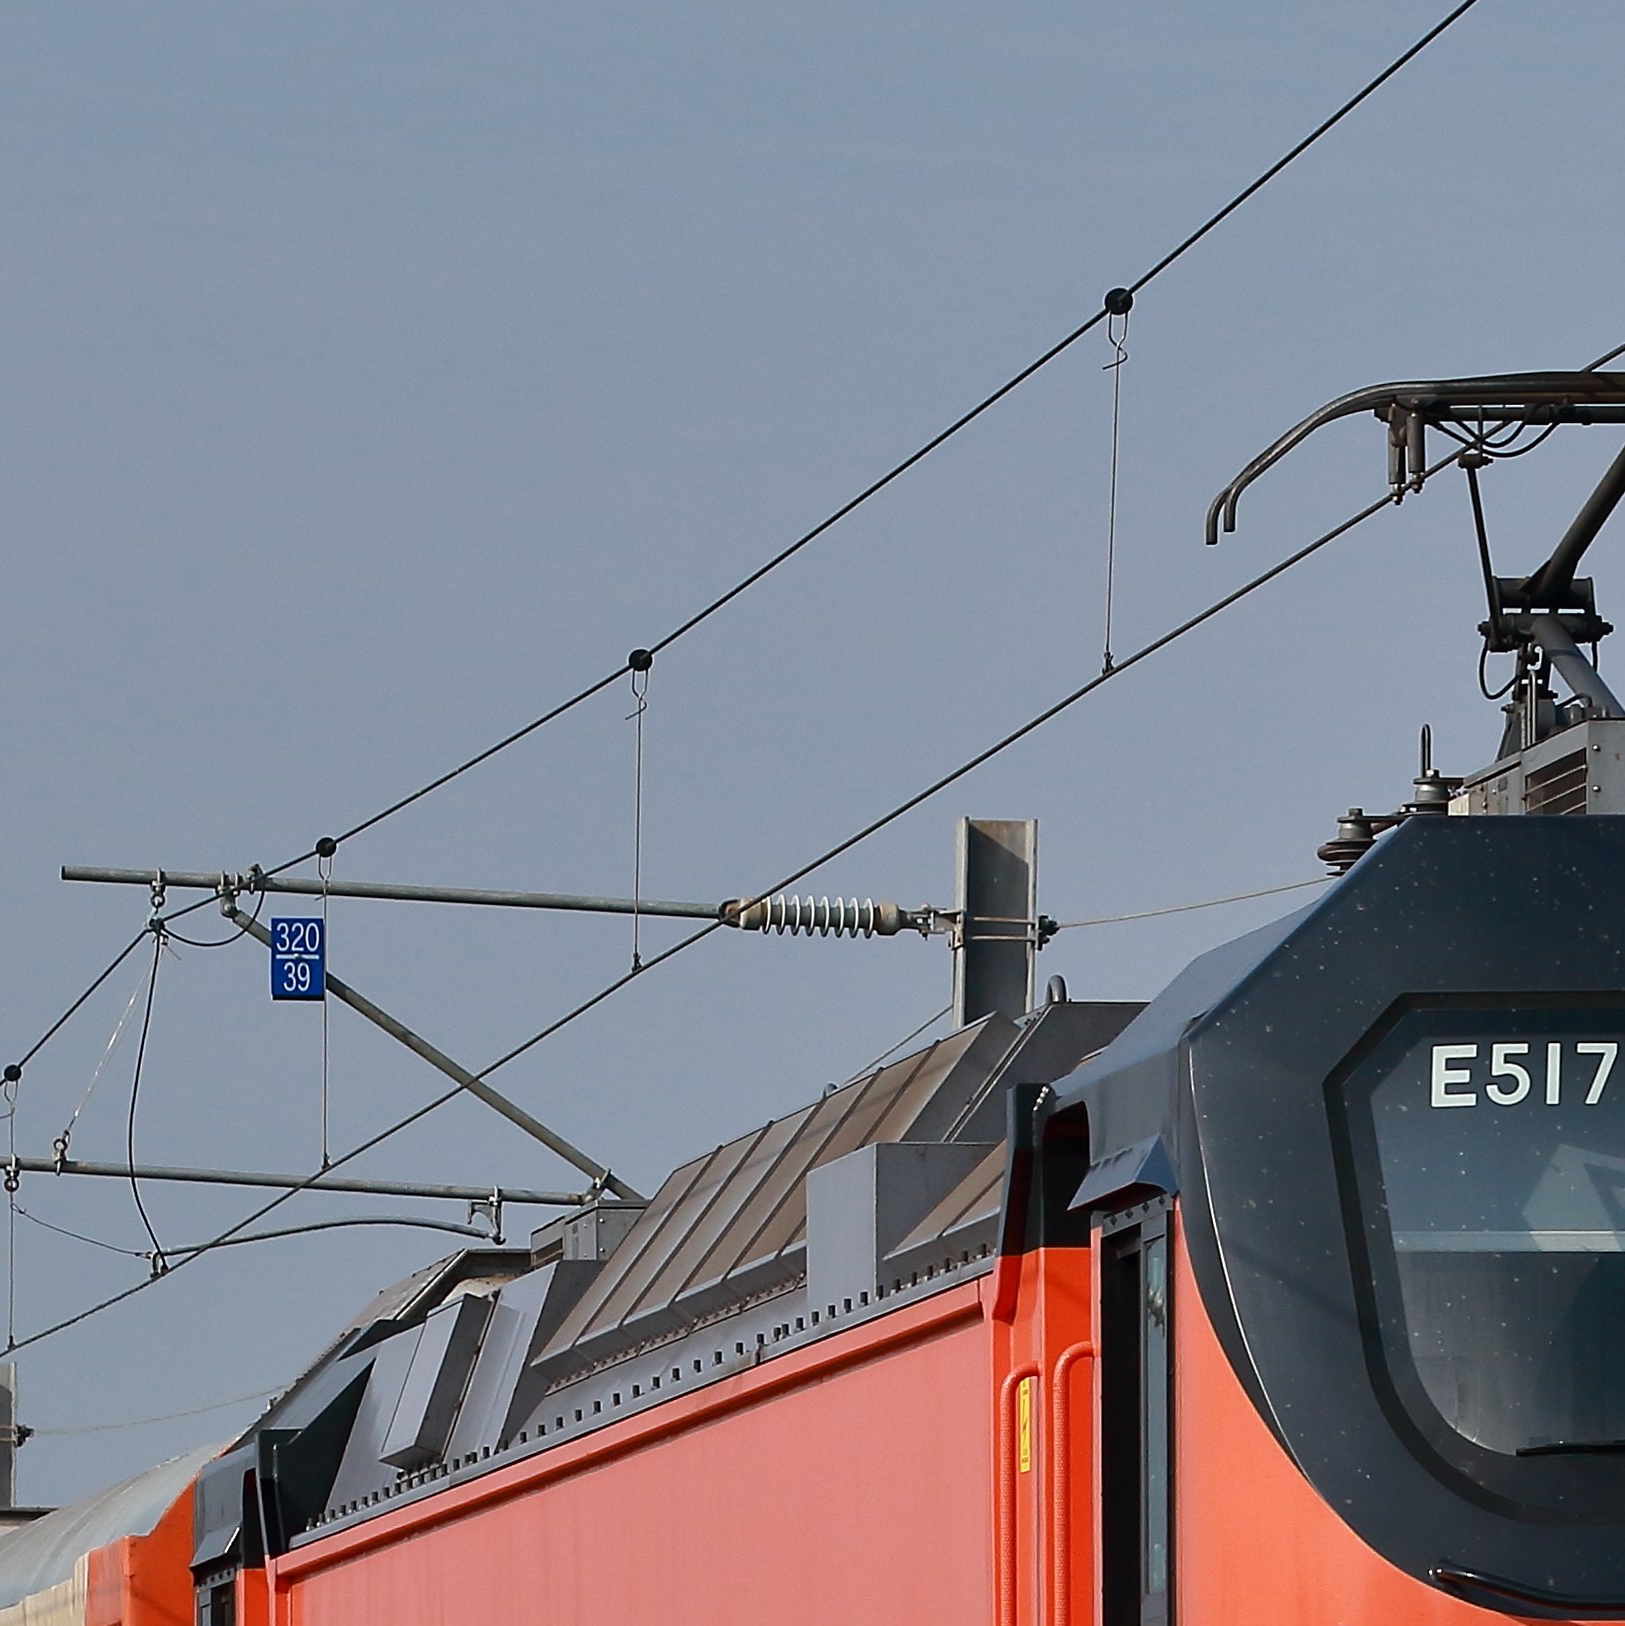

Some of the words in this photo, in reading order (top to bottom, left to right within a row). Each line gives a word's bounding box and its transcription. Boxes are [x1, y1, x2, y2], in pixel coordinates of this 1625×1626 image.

[276, 922, 320, 952] 320
[283, 962, 311, 992] 39
[1430, 1041, 1619, 1108] E517
